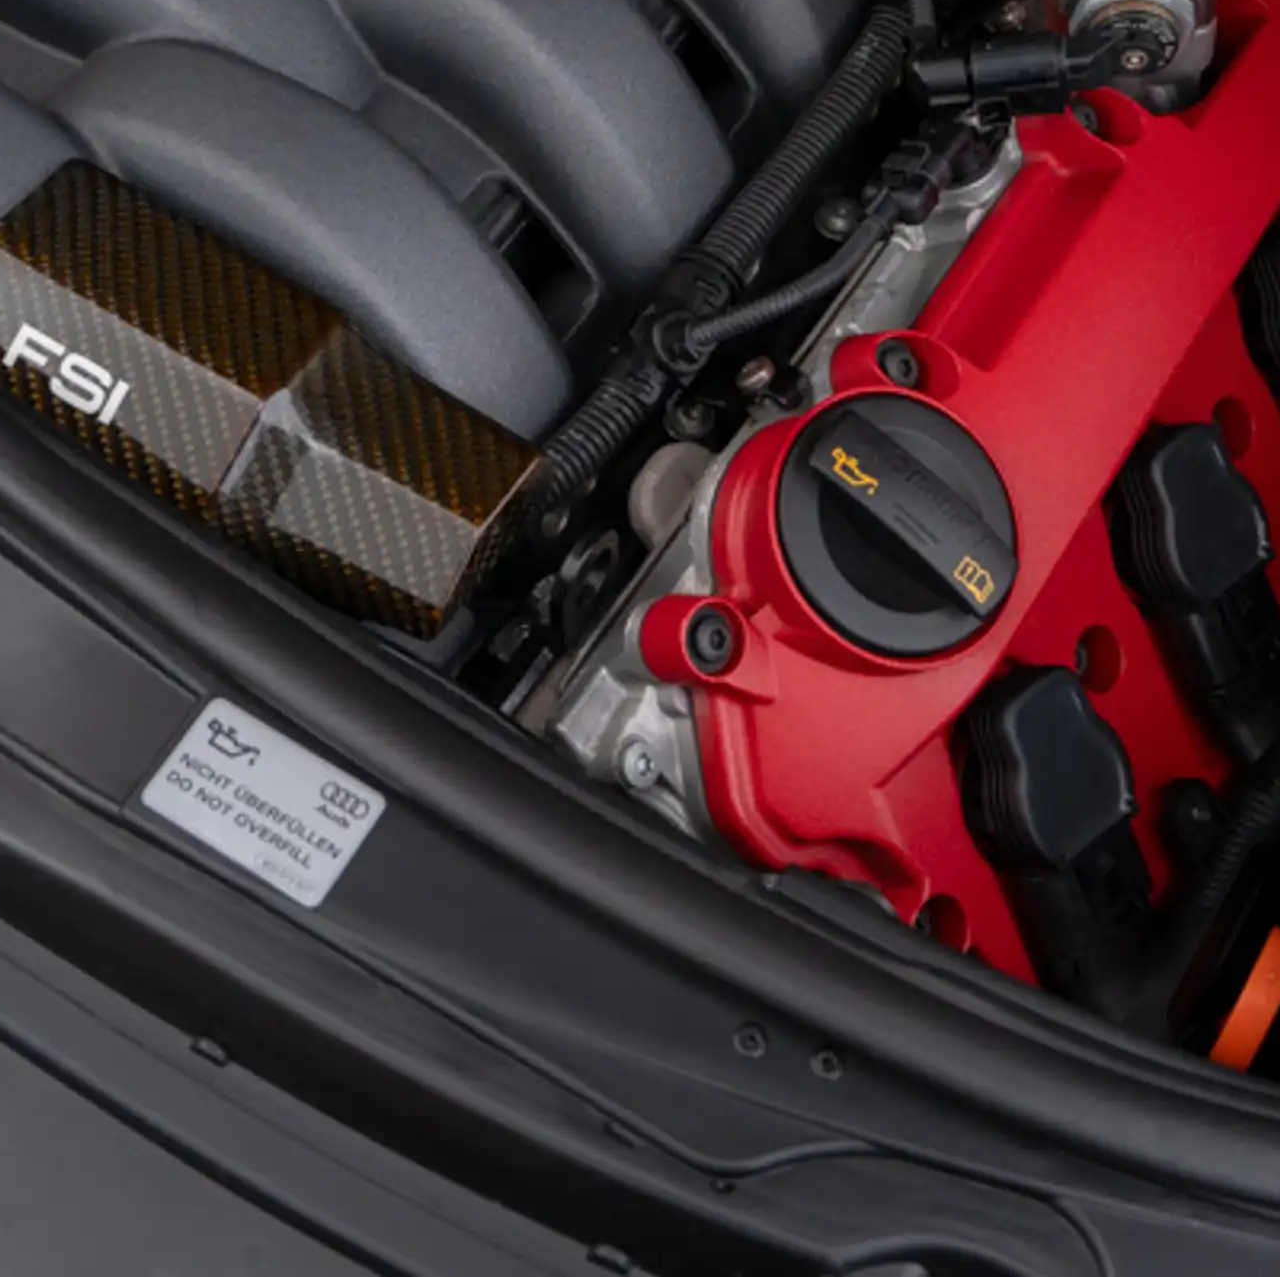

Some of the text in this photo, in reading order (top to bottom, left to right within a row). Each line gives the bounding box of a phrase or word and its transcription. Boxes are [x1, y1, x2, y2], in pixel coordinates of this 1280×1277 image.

[2, 323, 130, 425] FSI
[166, 769, 312, 869] DO NOT OVERFILL
[179, 752, 344, 860] NICHT ÜBERFÜLLEN
[315, 804, 351, 830] Audi
